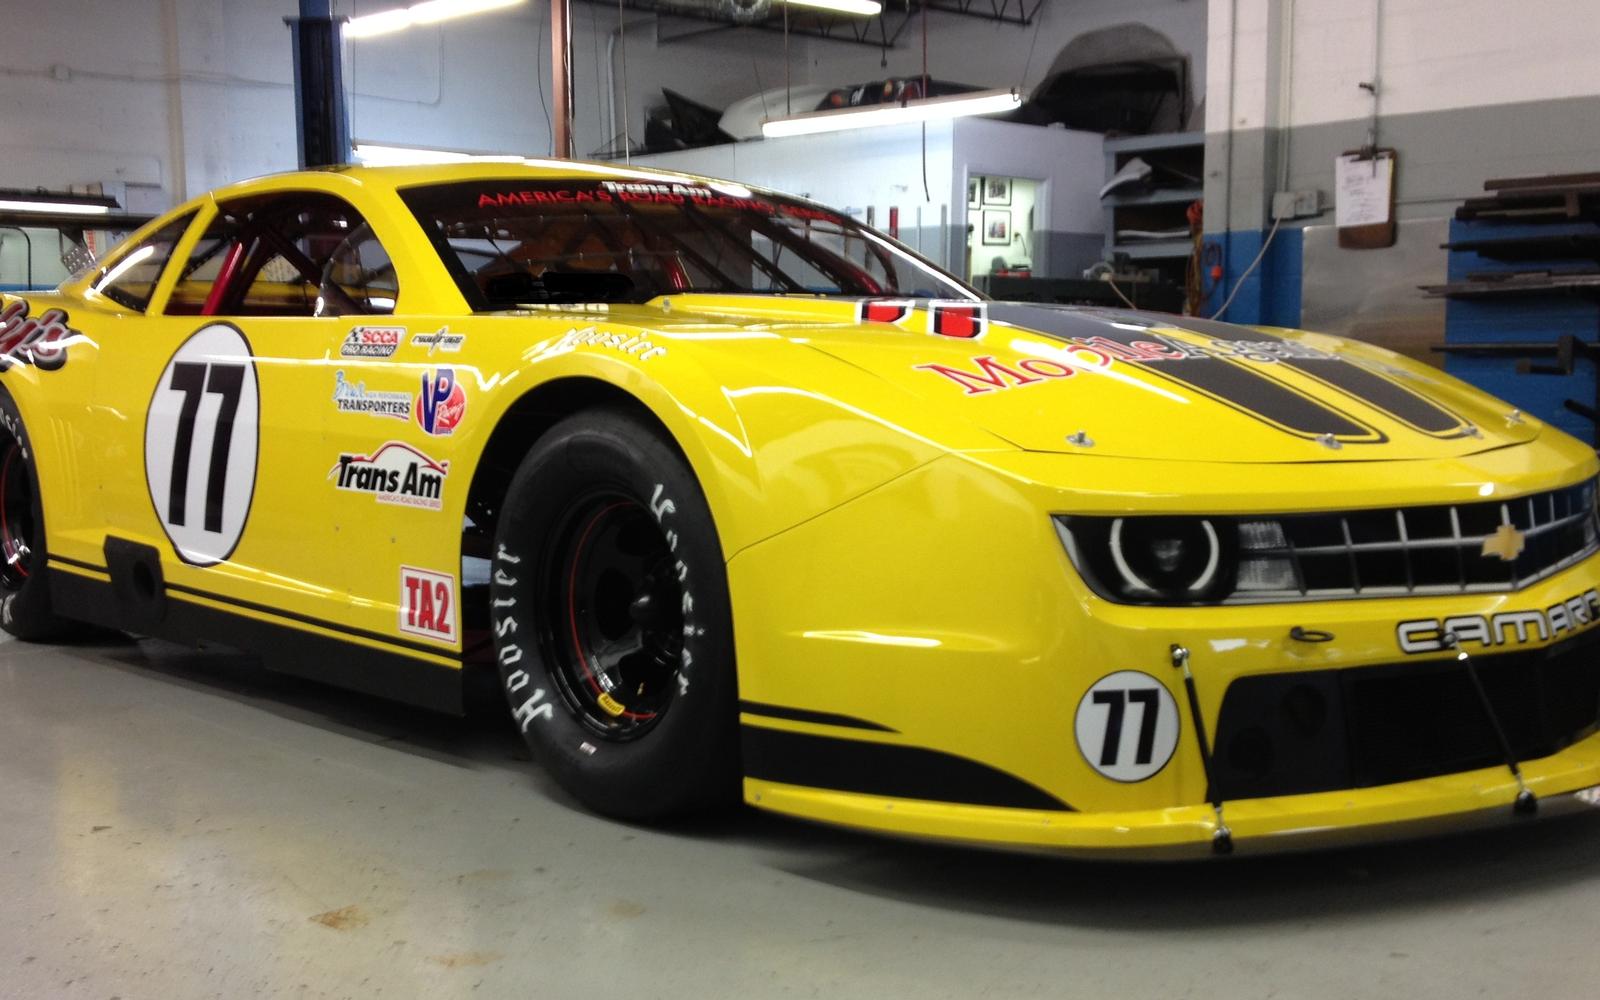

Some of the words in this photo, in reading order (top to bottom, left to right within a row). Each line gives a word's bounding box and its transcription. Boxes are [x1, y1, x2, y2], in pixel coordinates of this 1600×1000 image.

[478, 189, 612, 208] AMERICA'S
[361, 330, 398, 343] SCCA
[337, 399, 411, 414] TRANSPORTERS
[421, 368, 455, 434] VP
[168, 361, 247, 534] 77
[337, 455, 400, 493] Trans
[400, 462, 442, 499] Am
[405, 575, 450, 634] TA2
[493, 543, 554, 733] Hoosier
[1092, 688, 1160, 767] 77
